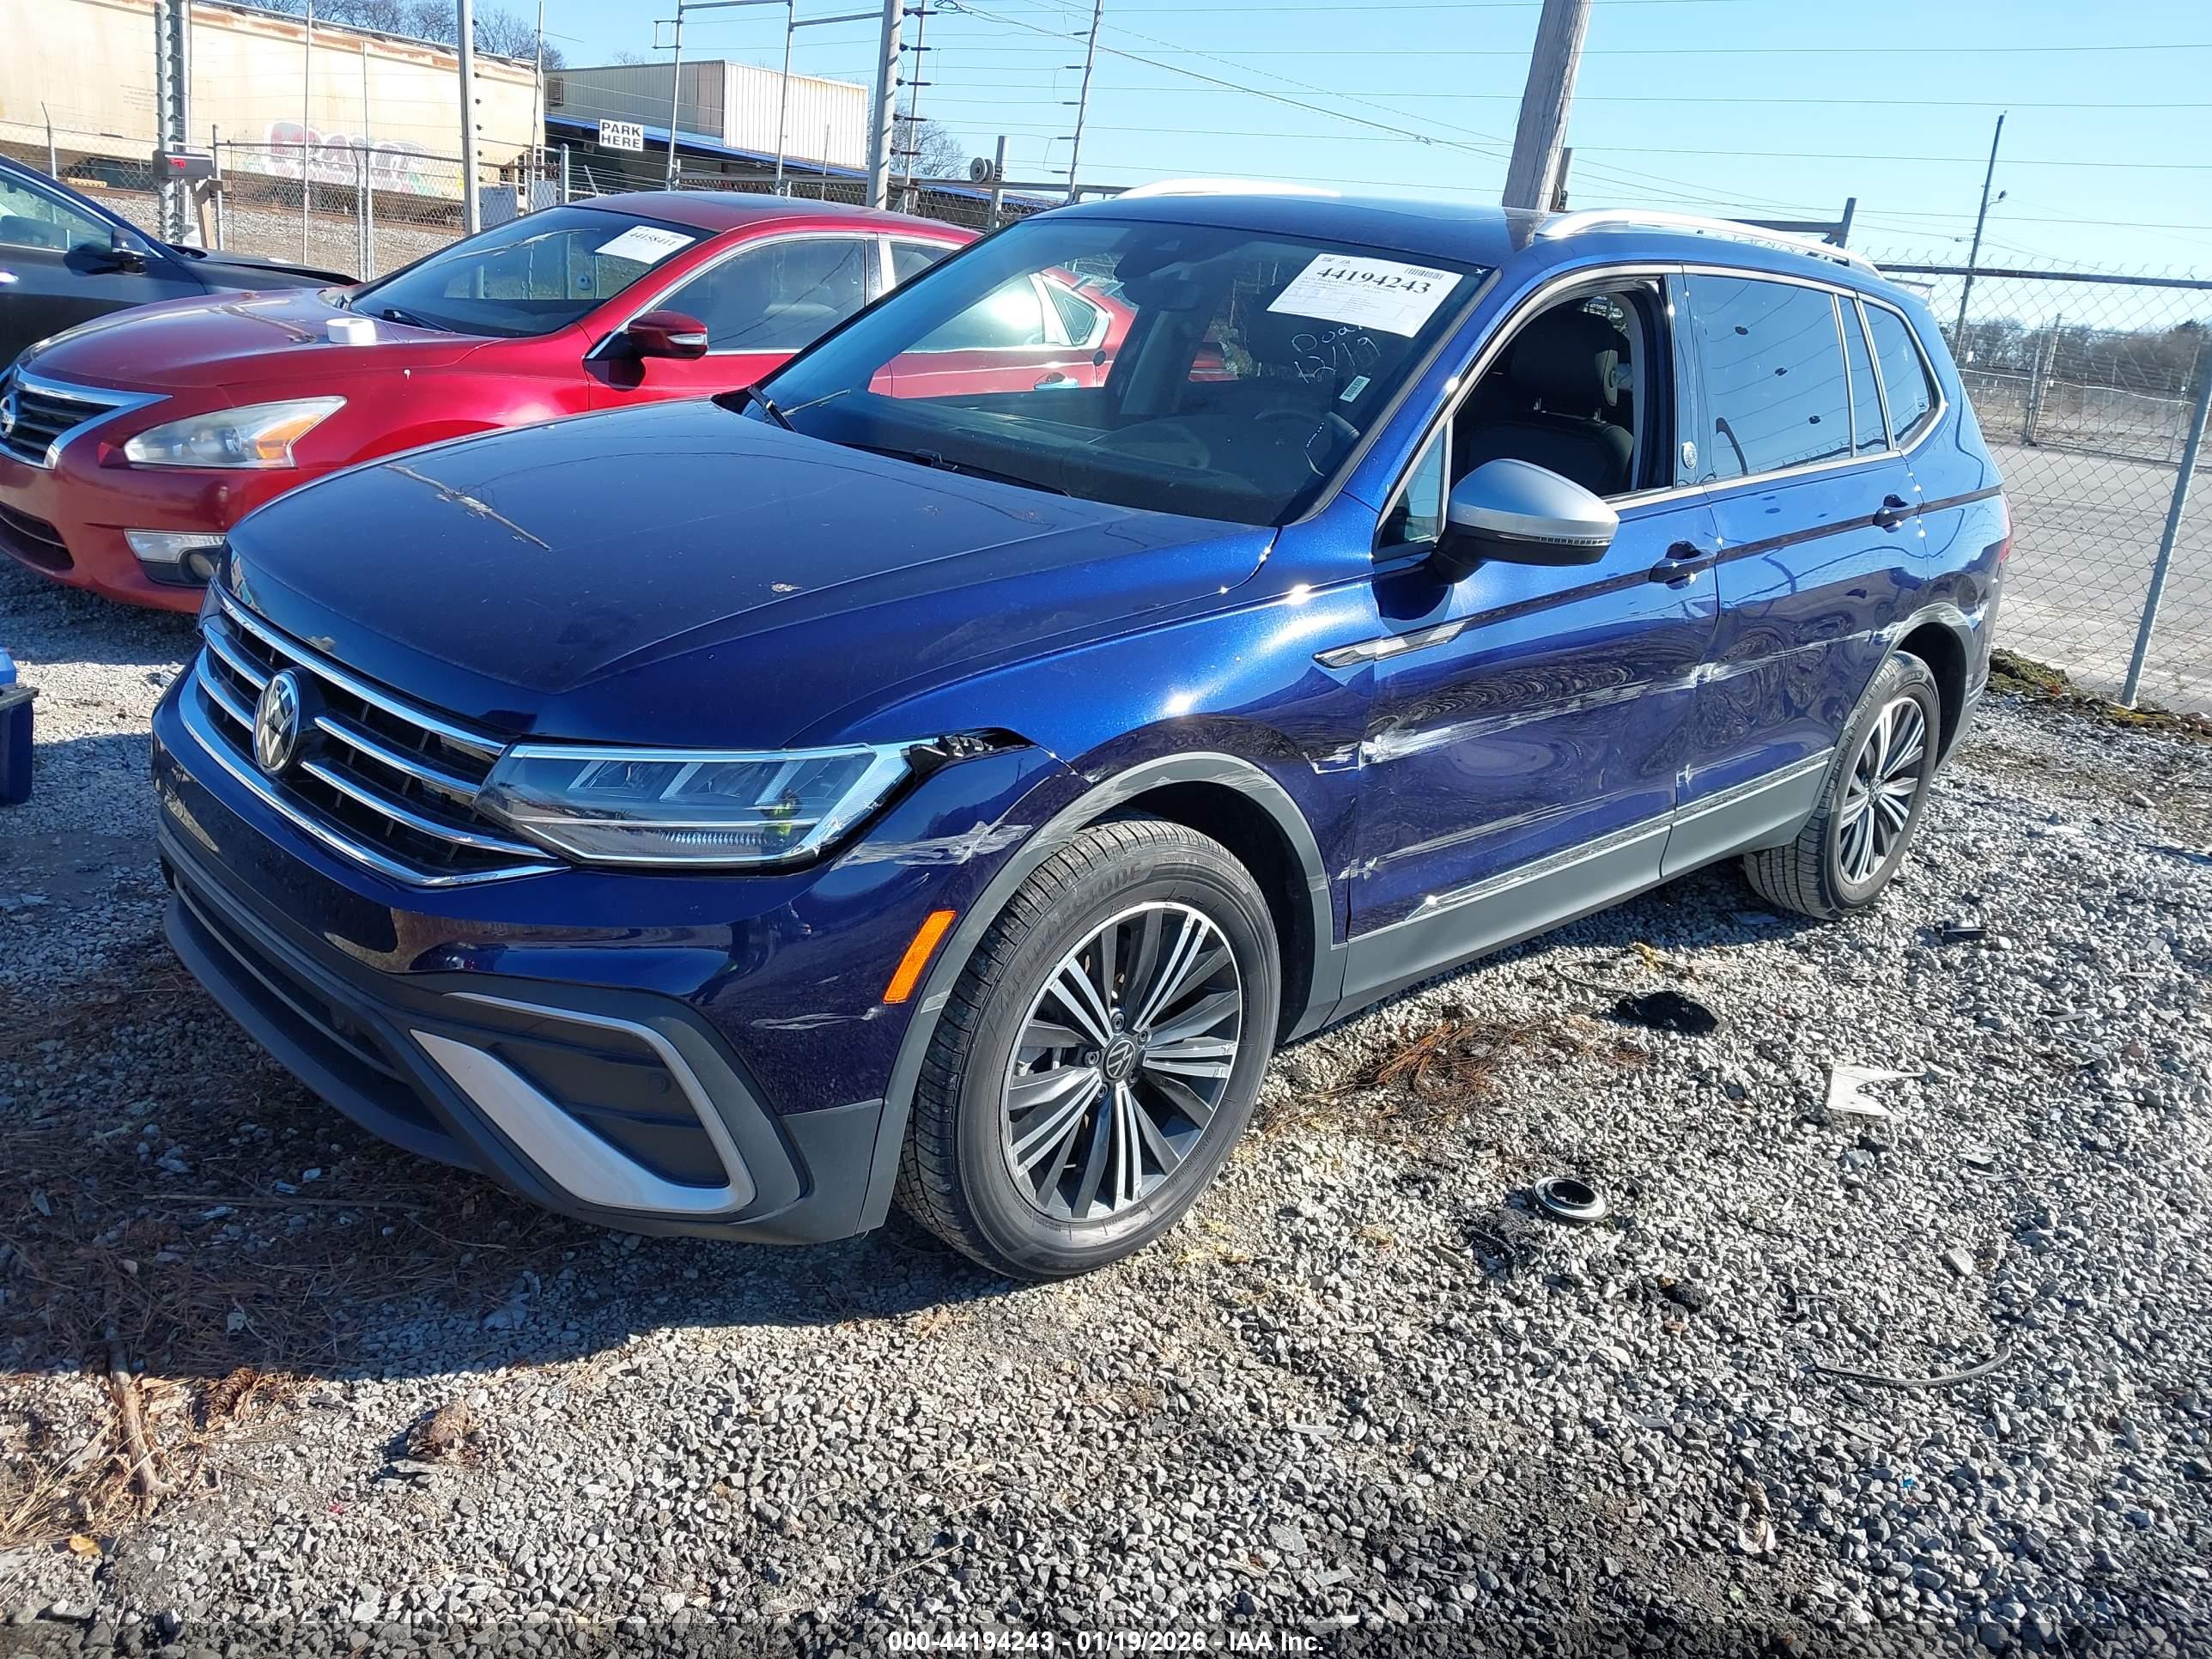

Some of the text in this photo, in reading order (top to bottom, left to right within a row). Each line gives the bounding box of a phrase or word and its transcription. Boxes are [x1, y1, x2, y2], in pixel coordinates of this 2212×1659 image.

[601, 122, 641, 137] PARK
[601, 133, 641, 149] HERE
[1316, 267, 1431, 295] 44194243
